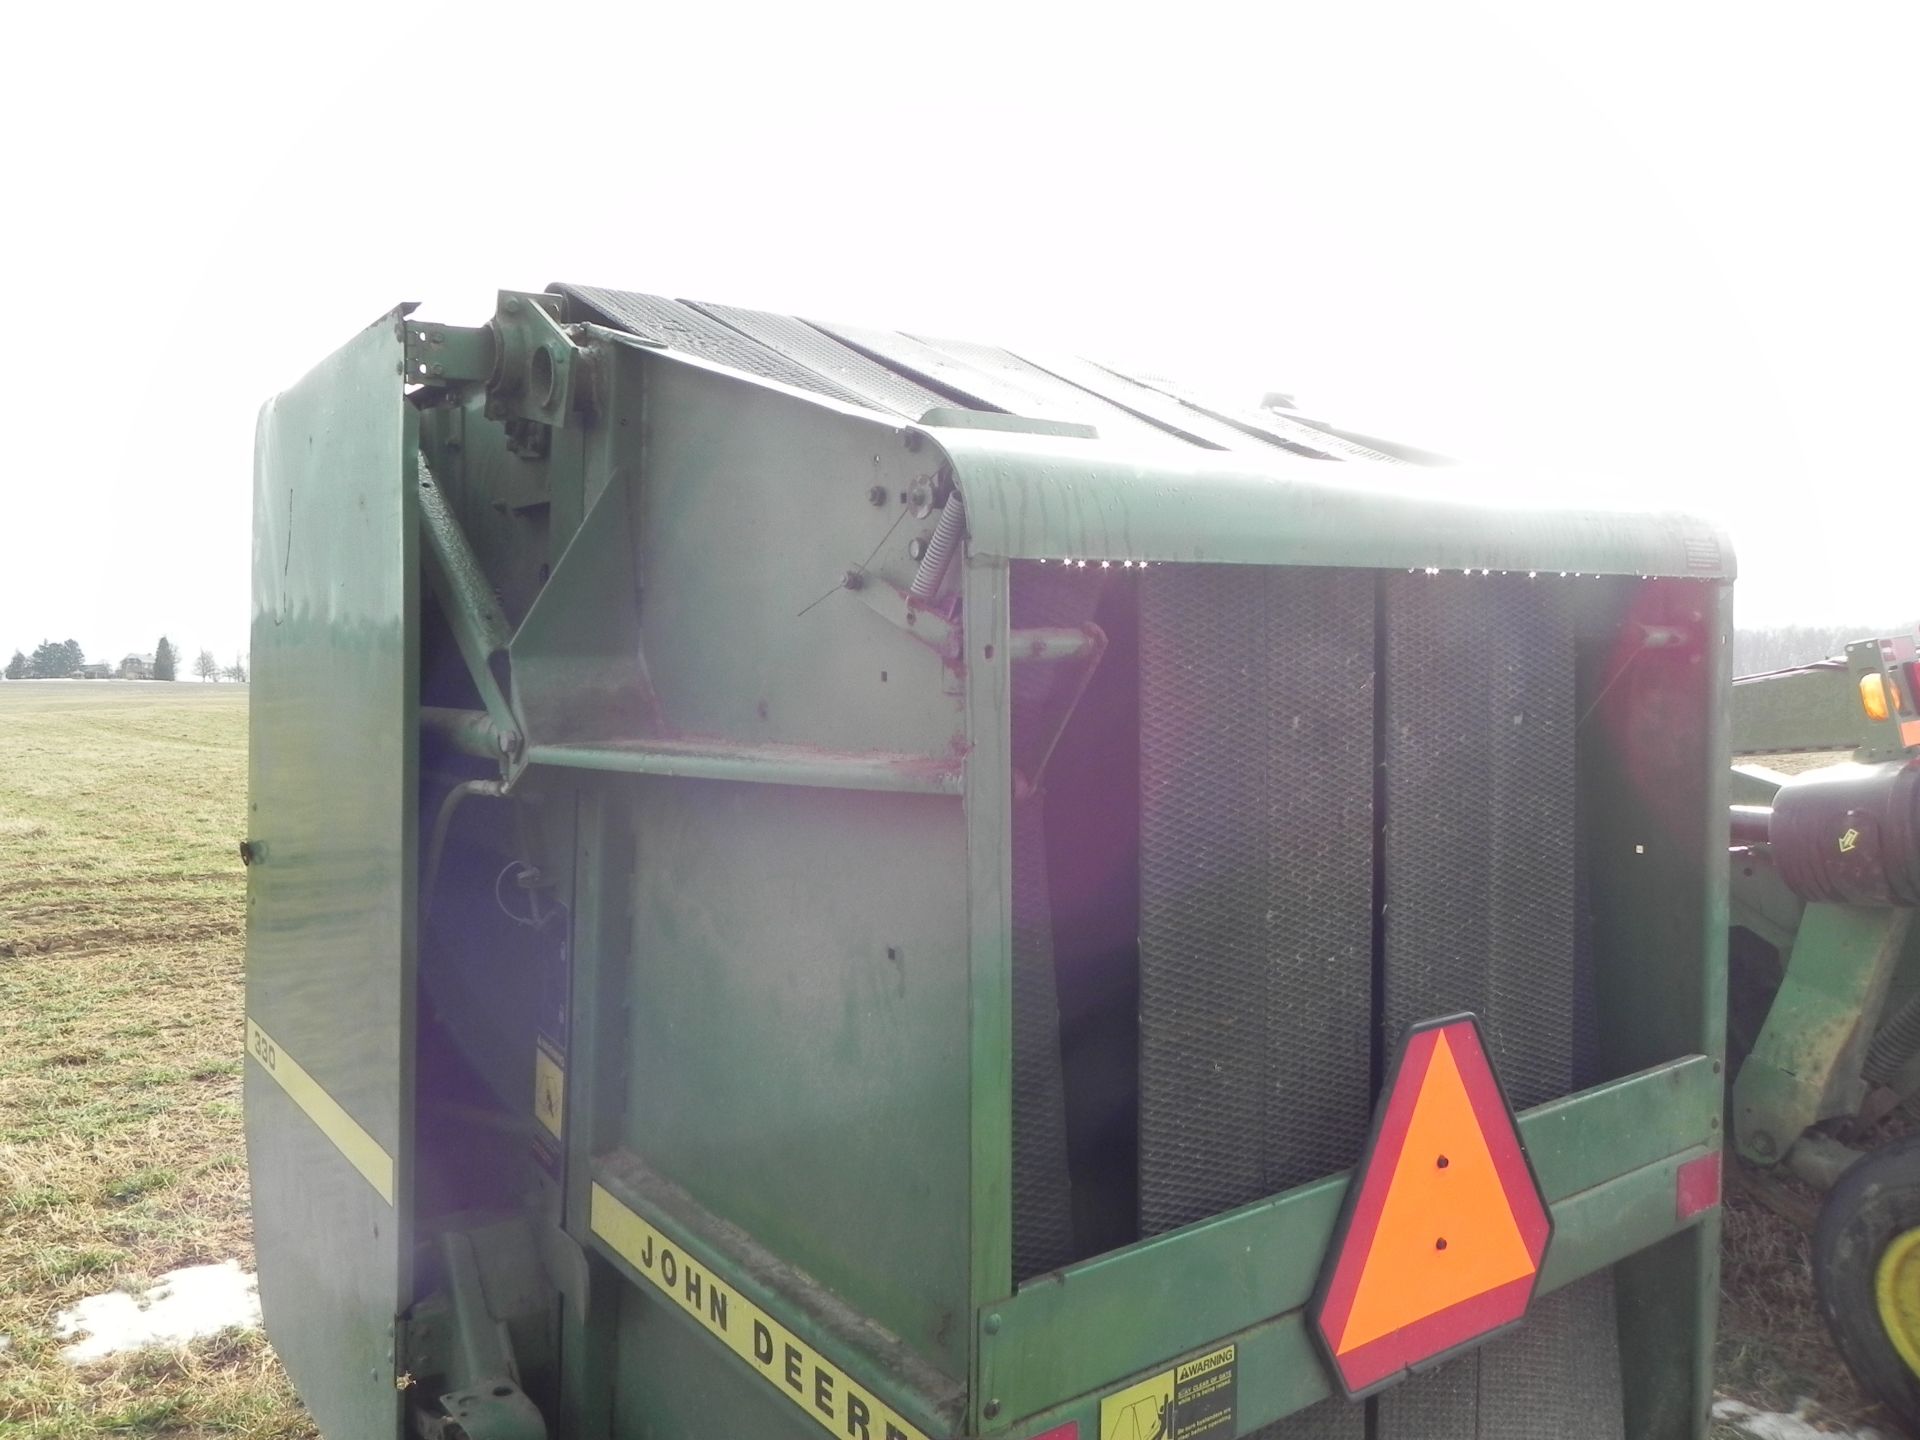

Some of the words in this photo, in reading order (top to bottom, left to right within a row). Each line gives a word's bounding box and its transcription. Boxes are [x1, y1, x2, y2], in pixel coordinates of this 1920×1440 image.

[255, 1031, 275, 1070] 330
[642, 1237, 727, 1331] JOHN
[1188, 1349, 1232, 1376] WARNING
[1193, 1380, 1209, 1391] CLEAR
